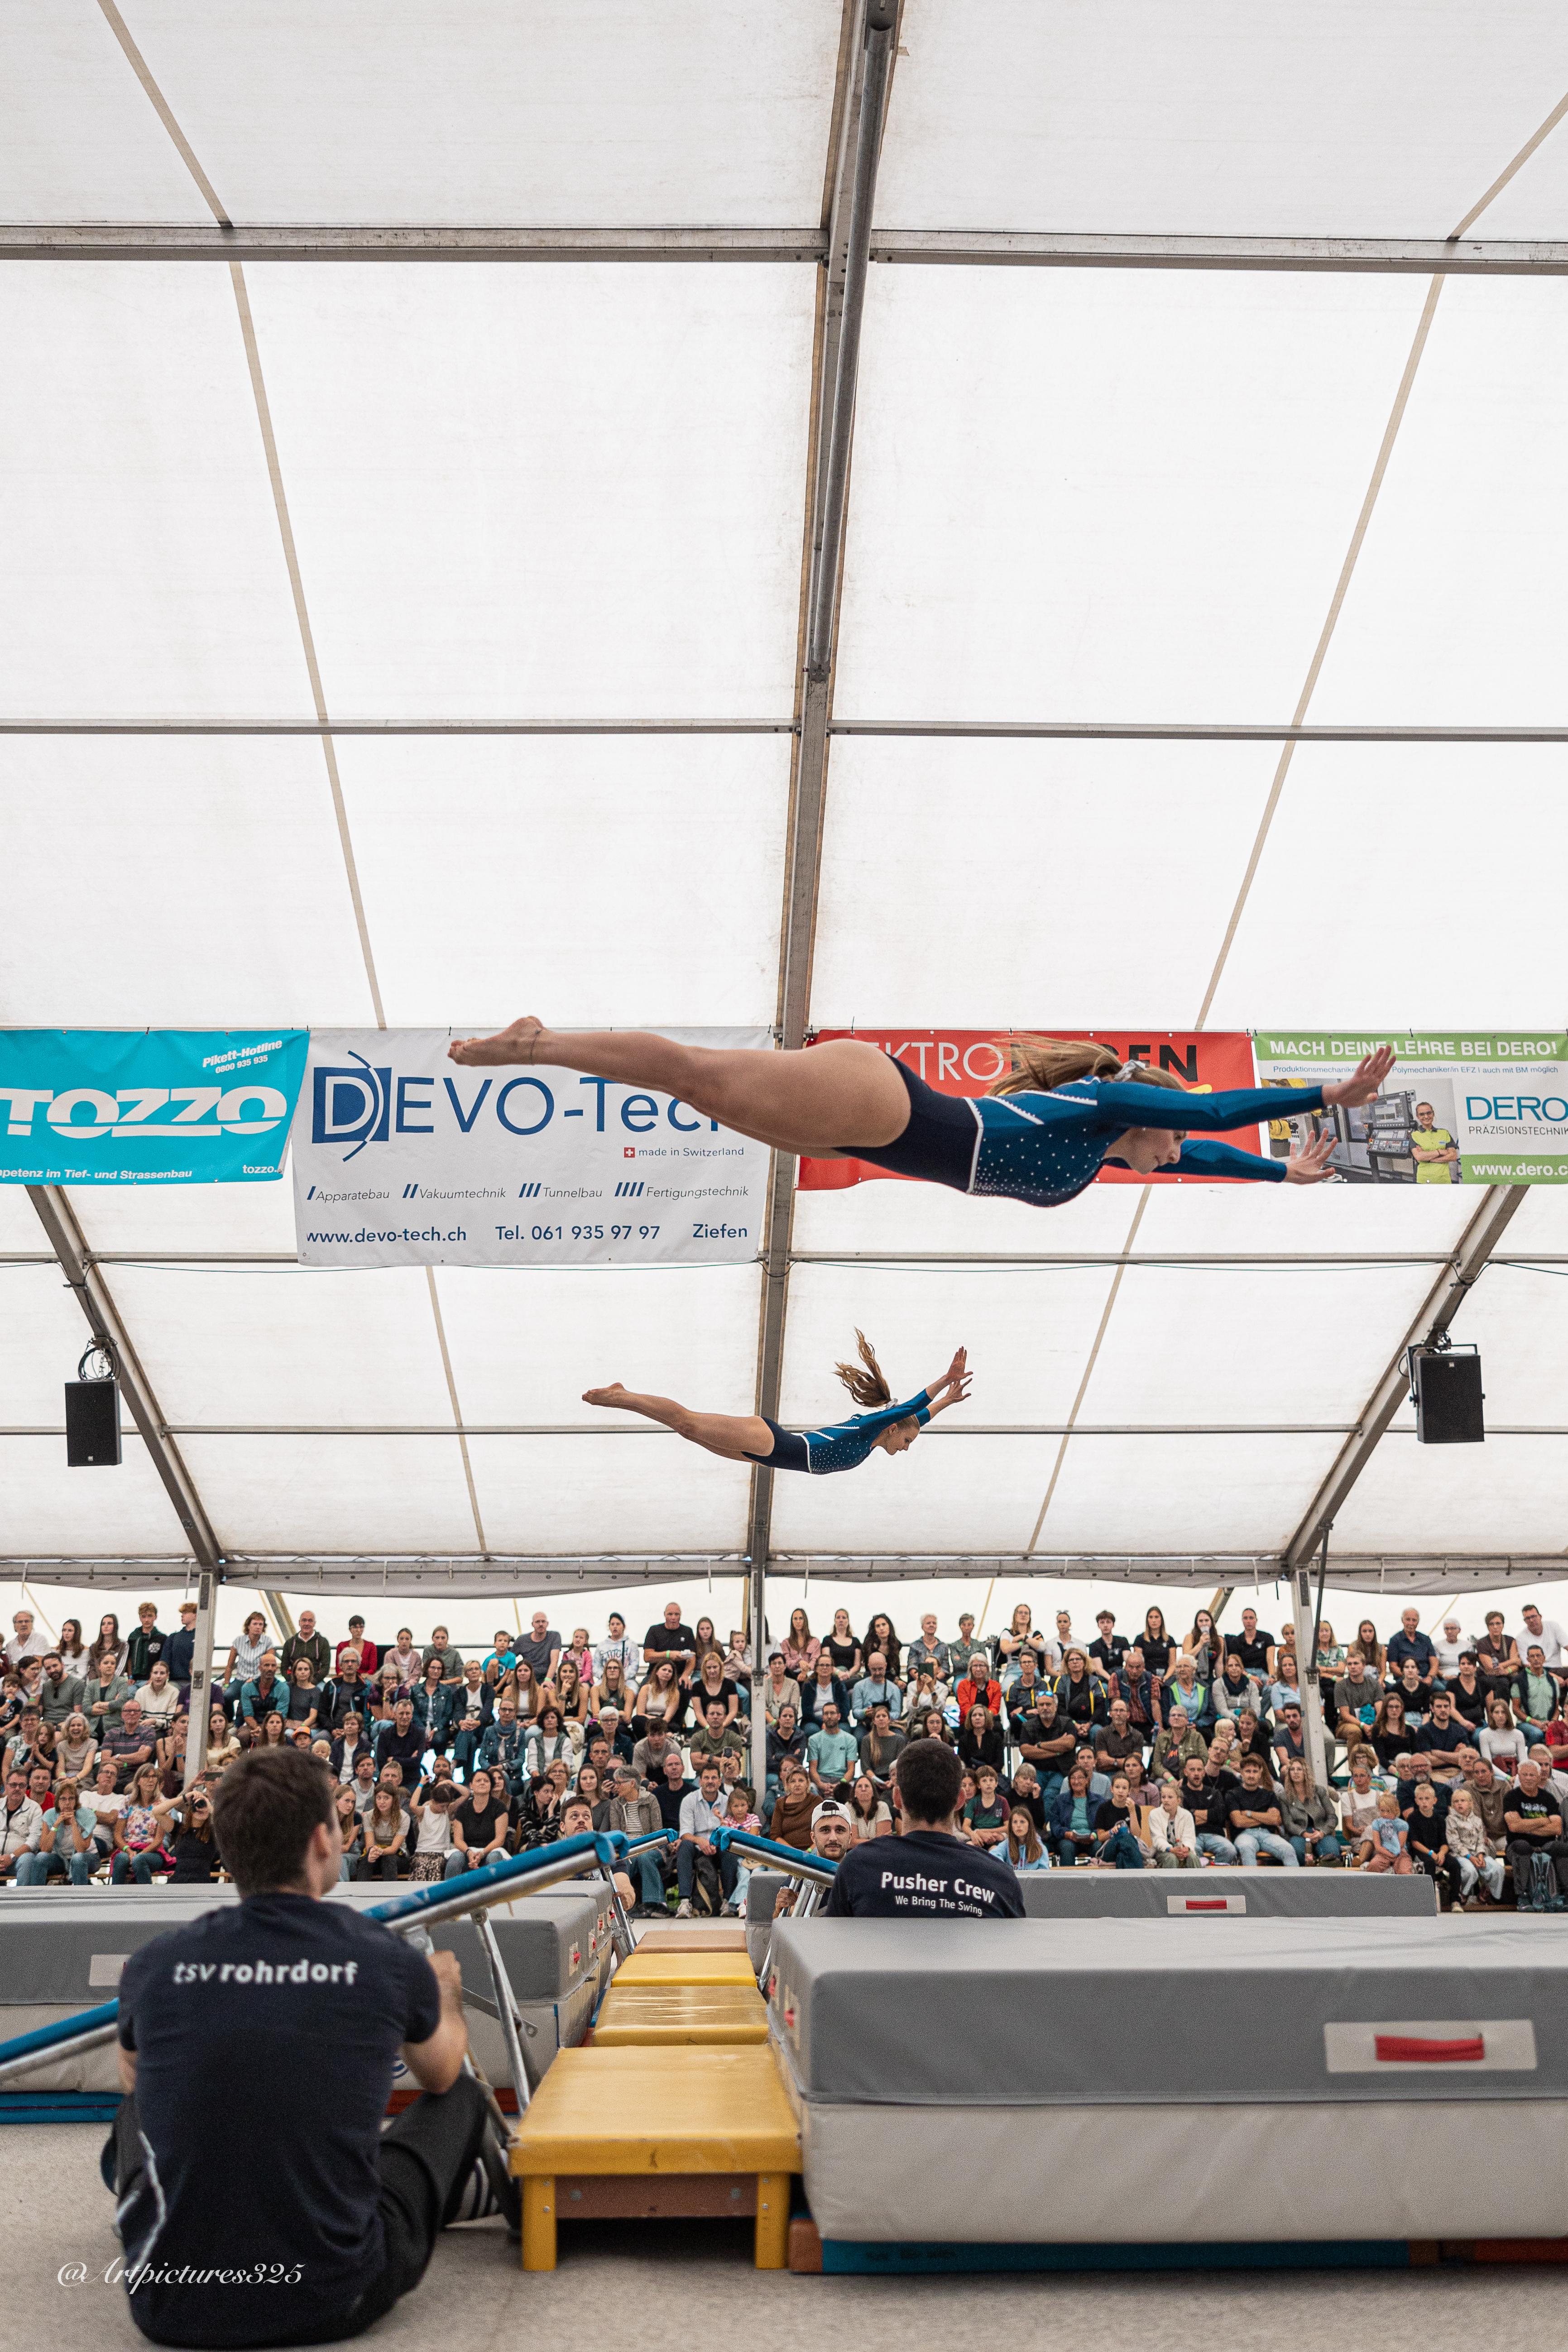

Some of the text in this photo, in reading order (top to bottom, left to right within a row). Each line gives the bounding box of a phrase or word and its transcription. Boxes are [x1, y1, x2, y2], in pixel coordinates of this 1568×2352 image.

[202, 1040, 283, 1068] Pikett-Hotline
[1270, 1040, 1324, 1055] MACH
[1393, 1041, 1456, 1055] LEHRE
[1461, 1042, 1491, 1056] BEI
[1497, 1041, 1558, 1056] DERO!
[215, 1055, 268, 1073] 0800 935 935
[1530, 1066, 1558, 1074] möglich
[312, 1067, 719, 1144] DEVO-Tec
[1466, 1096, 1568, 1121] DERO
[639, 1147, 744, 1157] made in Switzerland
[46, 1169, 61, 1178] im
[64, 1169, 91, 1178] Tief-
[94, 1170, 117, 1179] und
[120, 1169, 192, 1179] Strassenbau
[316, 1186, 749, 1203] Apparatebau Vakuumtechnik Tunnelbau Fertigungstechnik
[306, 1223, 748, 1243] www.devo-tech.ch Tel. 061 935 97 97 Ziefen
[881, 1872, 995, 1903] Pusher Crew
[895, 1896, 983, 1916] We Bring The Swing
[173, 1959, 359, 1985] tsv rohrdorf
